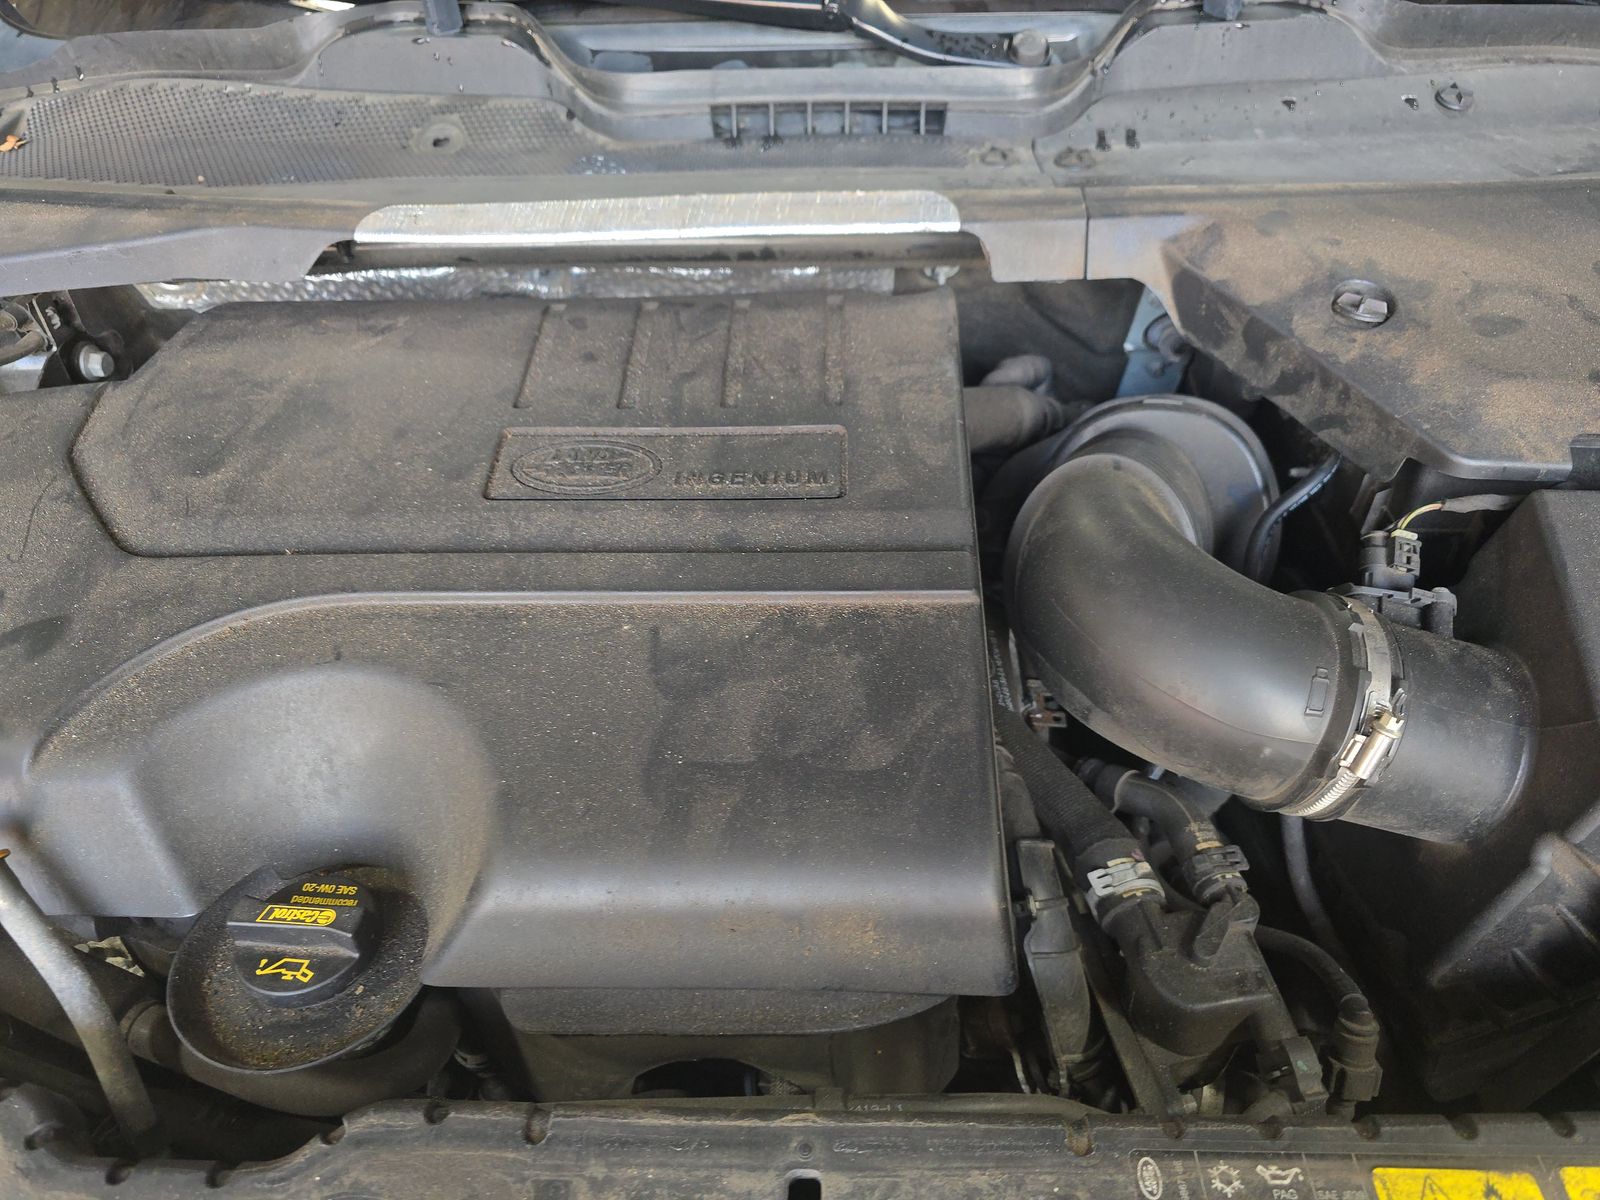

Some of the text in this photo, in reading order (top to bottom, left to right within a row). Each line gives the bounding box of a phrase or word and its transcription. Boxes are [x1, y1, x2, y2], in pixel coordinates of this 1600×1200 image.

[672, 470, 829, 487] INGENIUM
[302, 882, 358, 895] SAE 0W-20
[291, 896, 358, 906] recommended
[269, 908, 320, 922] Castrol
[1272, 1188, 1298, 1200] PAG
